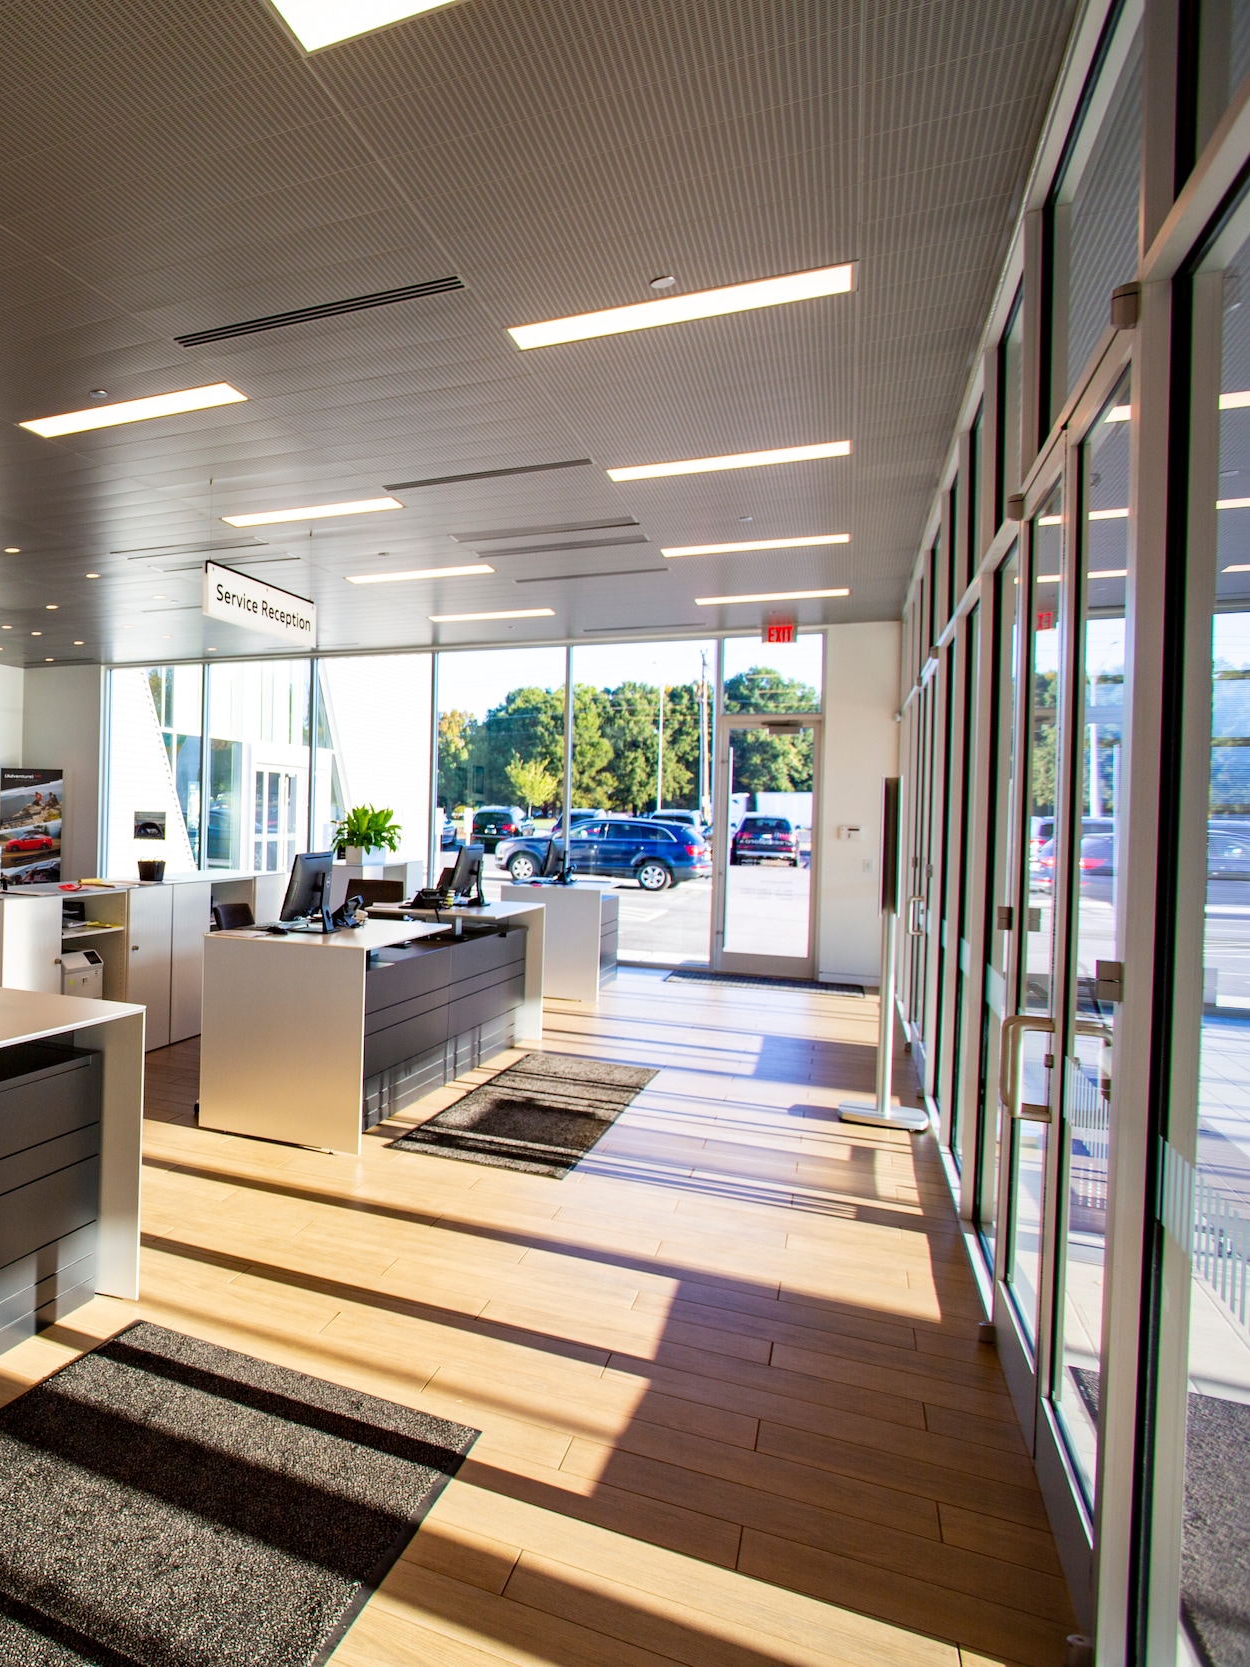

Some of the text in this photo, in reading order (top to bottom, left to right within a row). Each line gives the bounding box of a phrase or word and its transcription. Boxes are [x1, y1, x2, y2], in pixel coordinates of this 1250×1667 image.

[216, 583, 311, 632] Service Reception
[767, 625, 794, 643] EXIT
